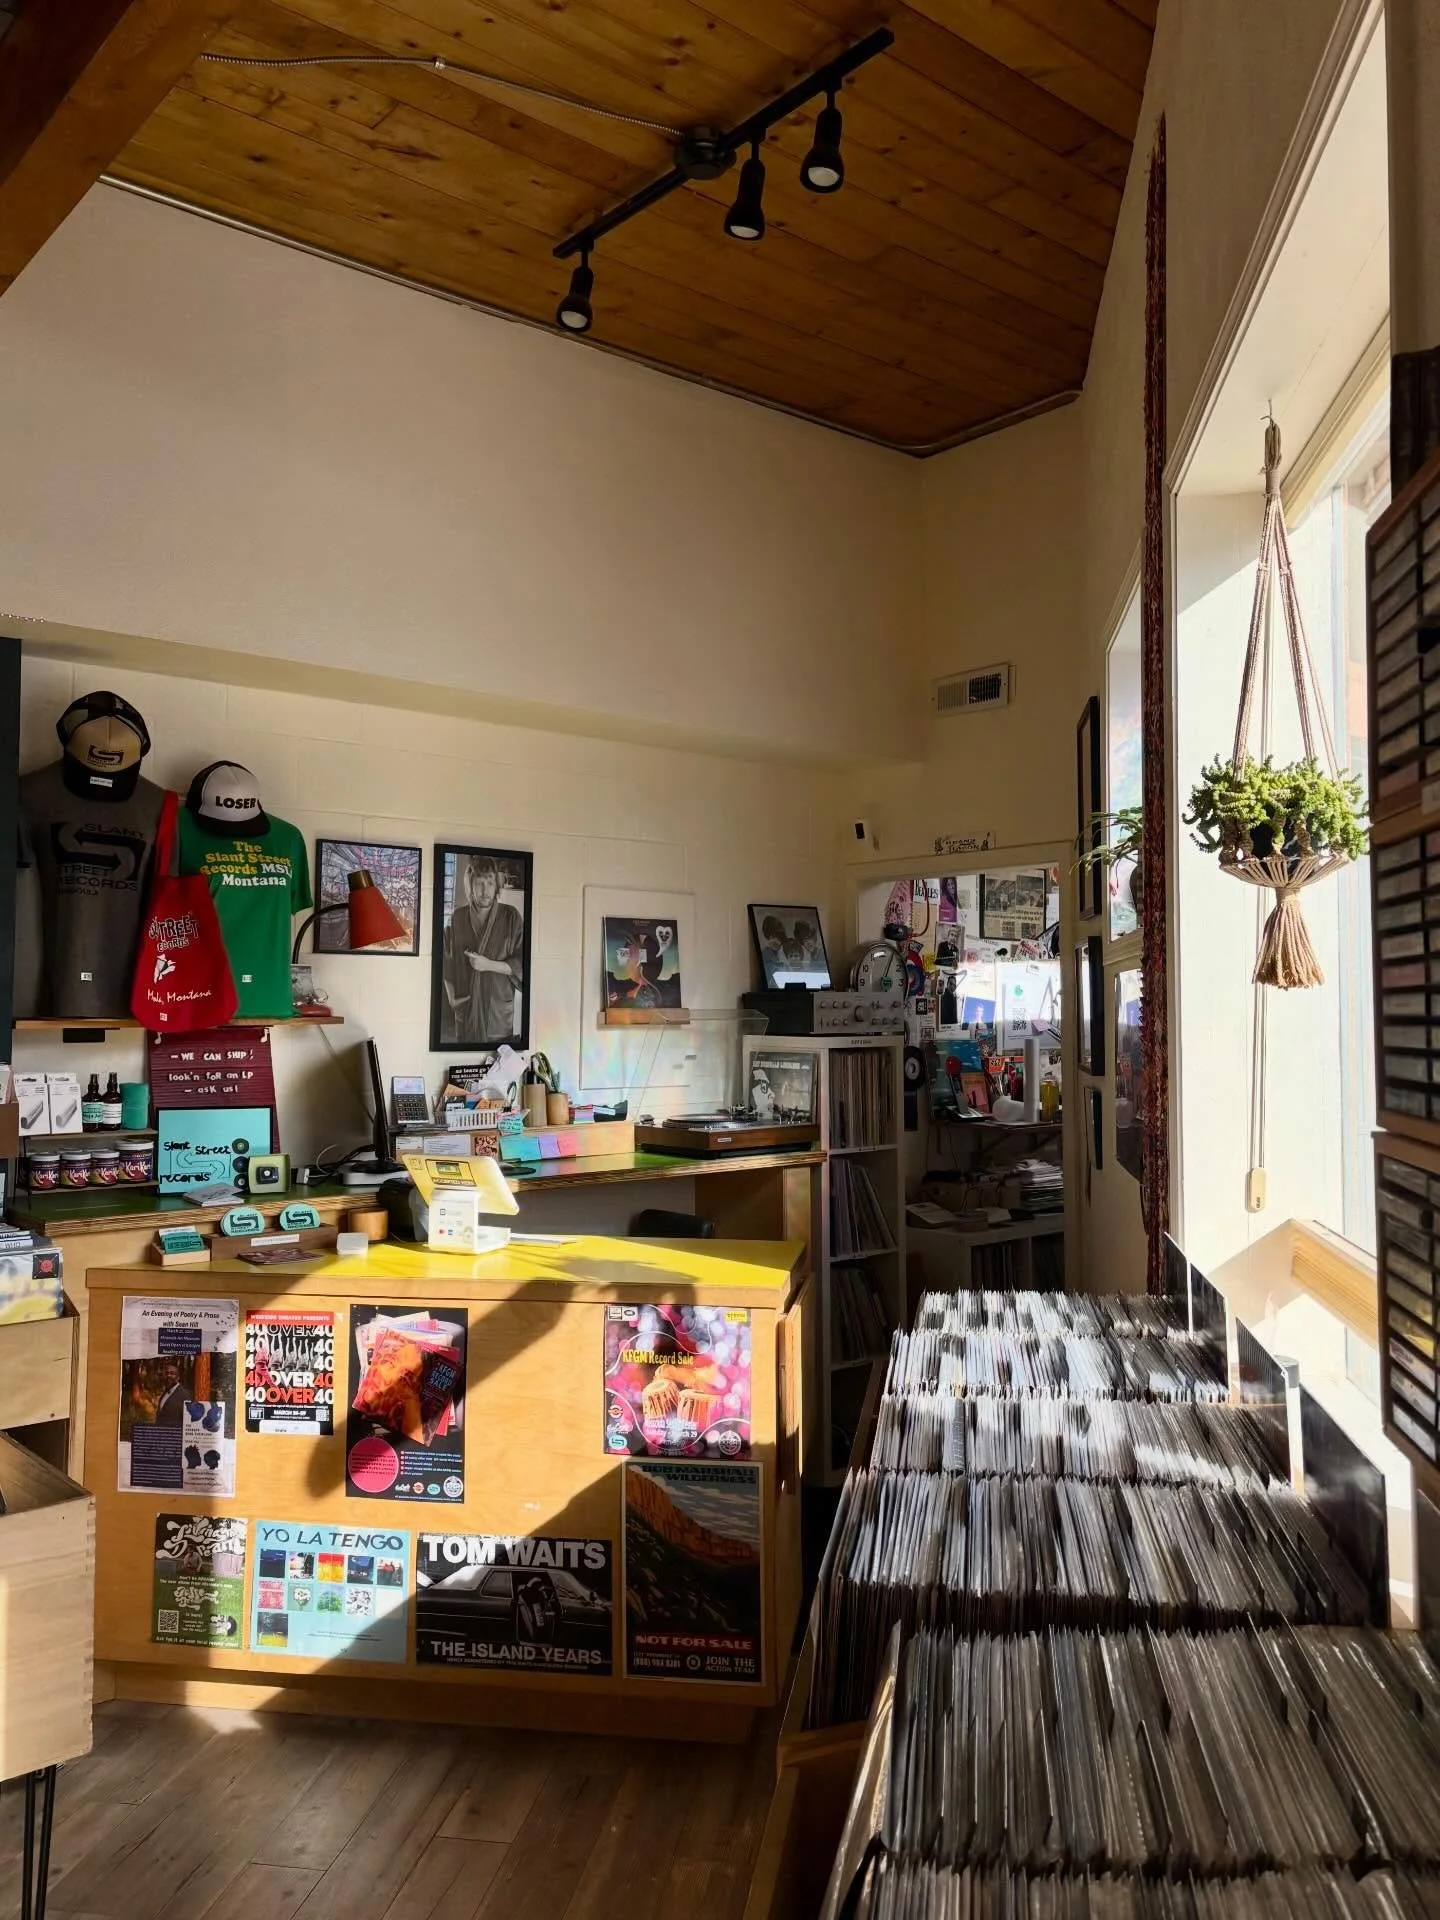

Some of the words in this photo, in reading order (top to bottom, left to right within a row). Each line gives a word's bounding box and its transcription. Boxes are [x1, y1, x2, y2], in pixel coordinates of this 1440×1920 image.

[215, 796, 257, 809] LOSER
[233, 841, 263, 853] The
[205, 852, 245, 863] Slant
[247, 853, 291, 867] Street
[222, 873, 287, 887] Montana
[167, 989, 212, 1003] Montana
[181, 1052, 195, 1061] WE
[204, 1052, 222, 1061] CAN
[242, 1071, 254, 1080] LP
[163, 1141, 191, 1151] Slant
[195, 1145, 231, 1155] Street
[160, 1173, 211, 1184] records
[150, 1310, 172, 1318] Evening
[180, 1311, 198, 1319] Poetry
[203, 1311, 220, 1319] Prose
[267, 1324, 315, 1336] OVER
[623, 1349, 648, 1363] KFGM
[648, 1350, 677, 1364] Record
[677, 1352, 694, 1365] Sale
[269, 1371, 315, 1388] OVER
[245, 1387, 266, 1403] 40
[266, 1387, 315, 1404] OVER
[665, 1473, 757, 1483] WILDERNESS
[261, 1527, 290, 1543] YO
[297, 1530, 323, 1546] LA
[328, 1532, 404, 1551] TENGO
[422, 1535, 497, 1564] TOM
[503, 1540, 606, 1569] WAITS
[634, 1635, 670, 1645] NOT
[672, 1636, 706, 1647] FOR
[708, 1638, 753, 1650] SALE
[430, 1640, 466, 1657] THE
[471, 1643, 536, 1660] ISLAND
[542, 1648, 603, 1665] YEARS
[705, 1655, 730, 1665] JOIN
[733, 1657, 756, 1668] THE
